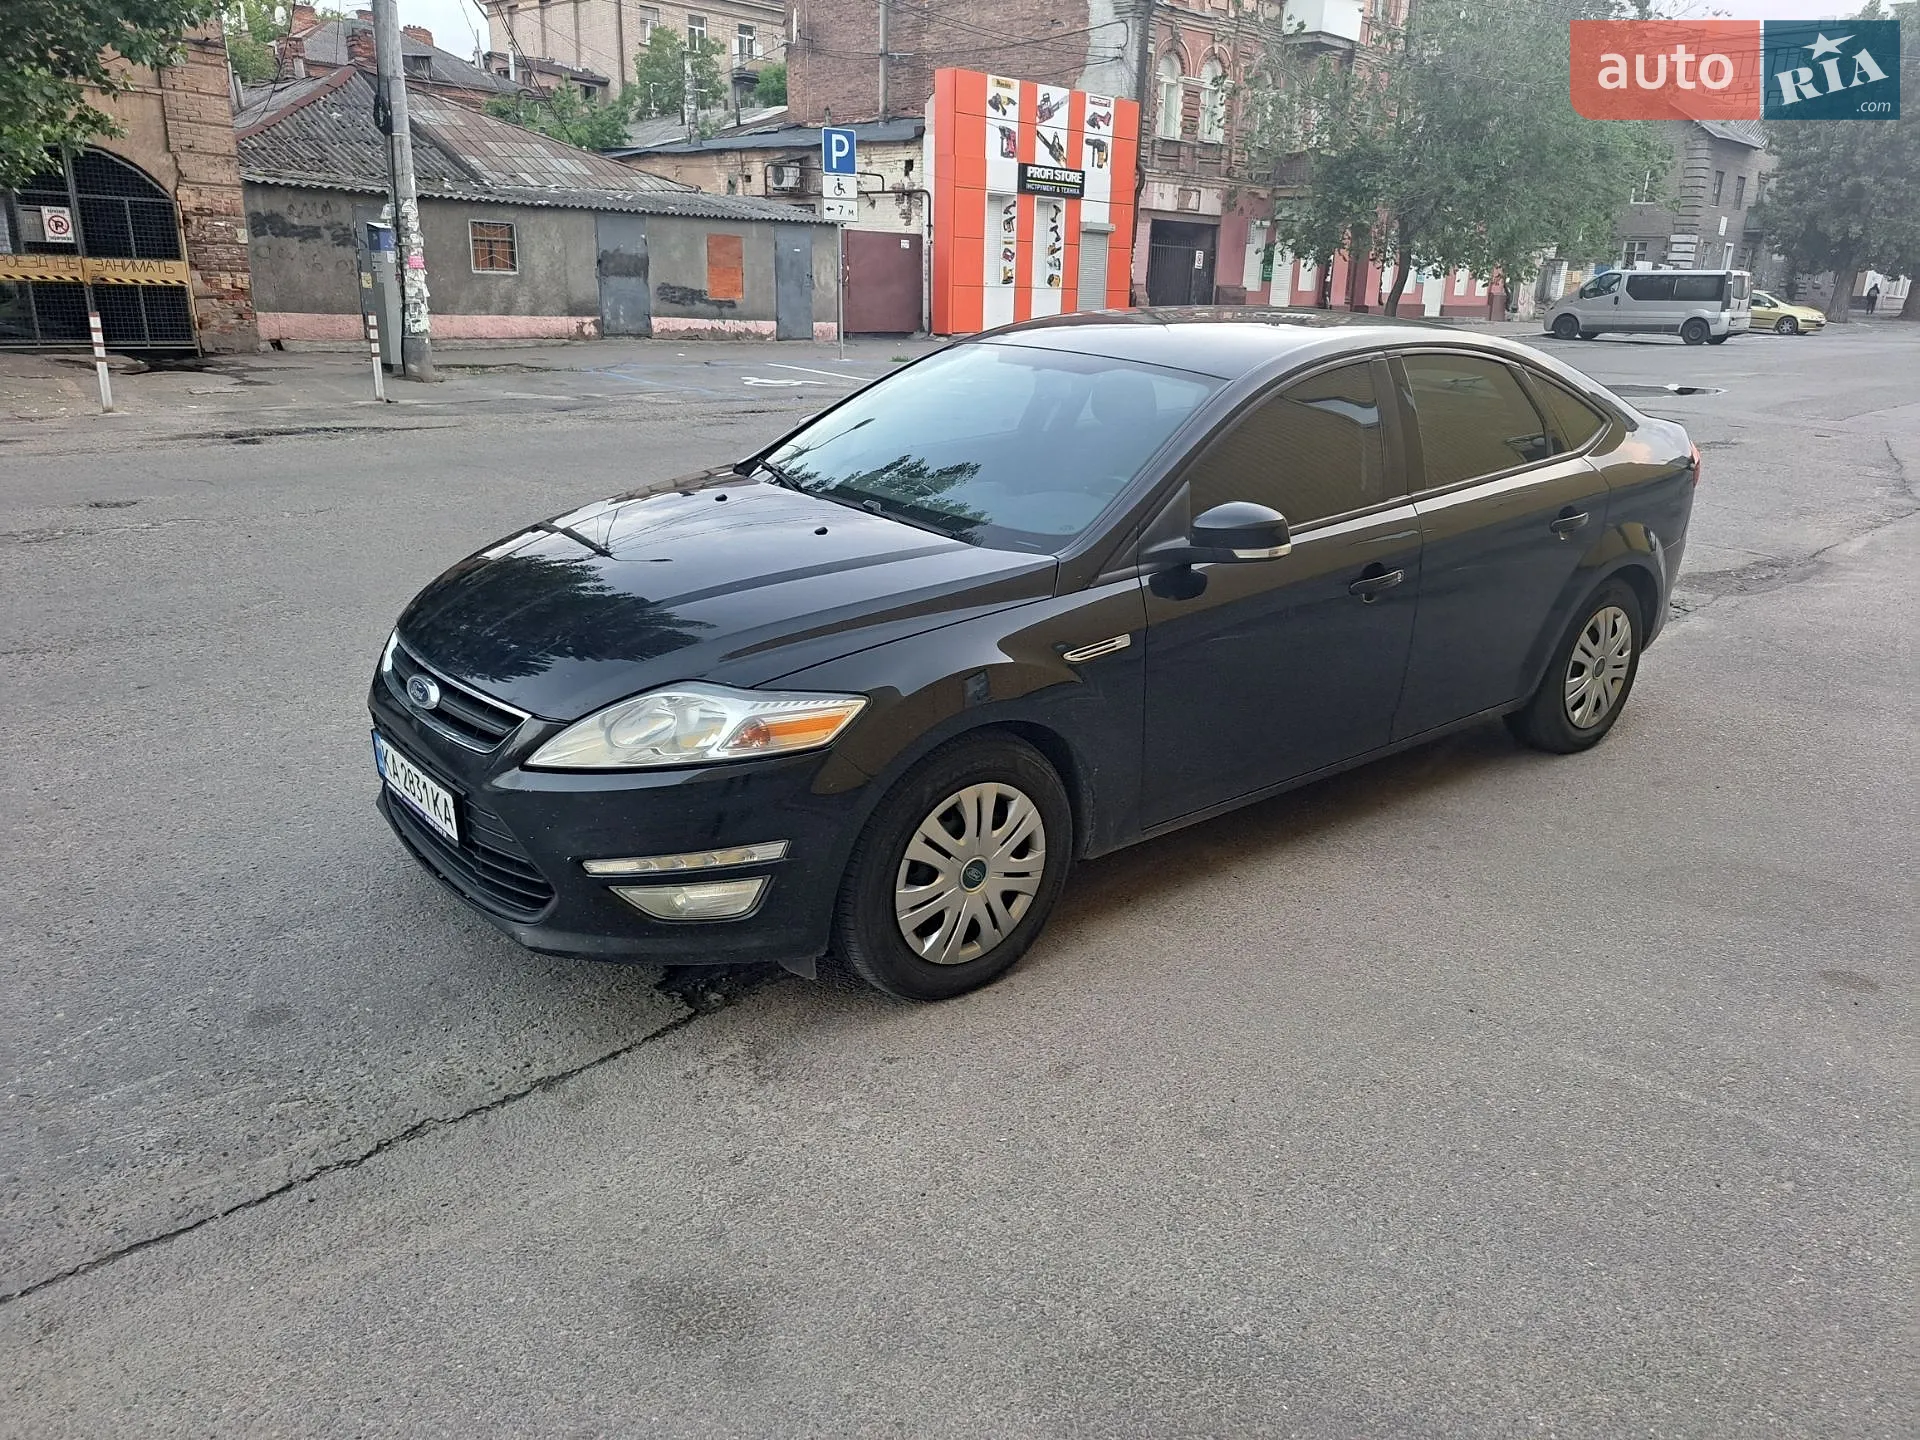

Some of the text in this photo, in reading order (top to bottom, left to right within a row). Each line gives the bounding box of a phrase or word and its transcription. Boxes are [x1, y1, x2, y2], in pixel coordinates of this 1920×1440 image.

[831, 133, 849, 169] P
[1026, 166, 1082, 183] PROFI STORE
[838, 205, 844, 216] 7
[56, 255, 79, 270] НЕ
[91, 260, 175, 275] ЗАНИМАТЬ
